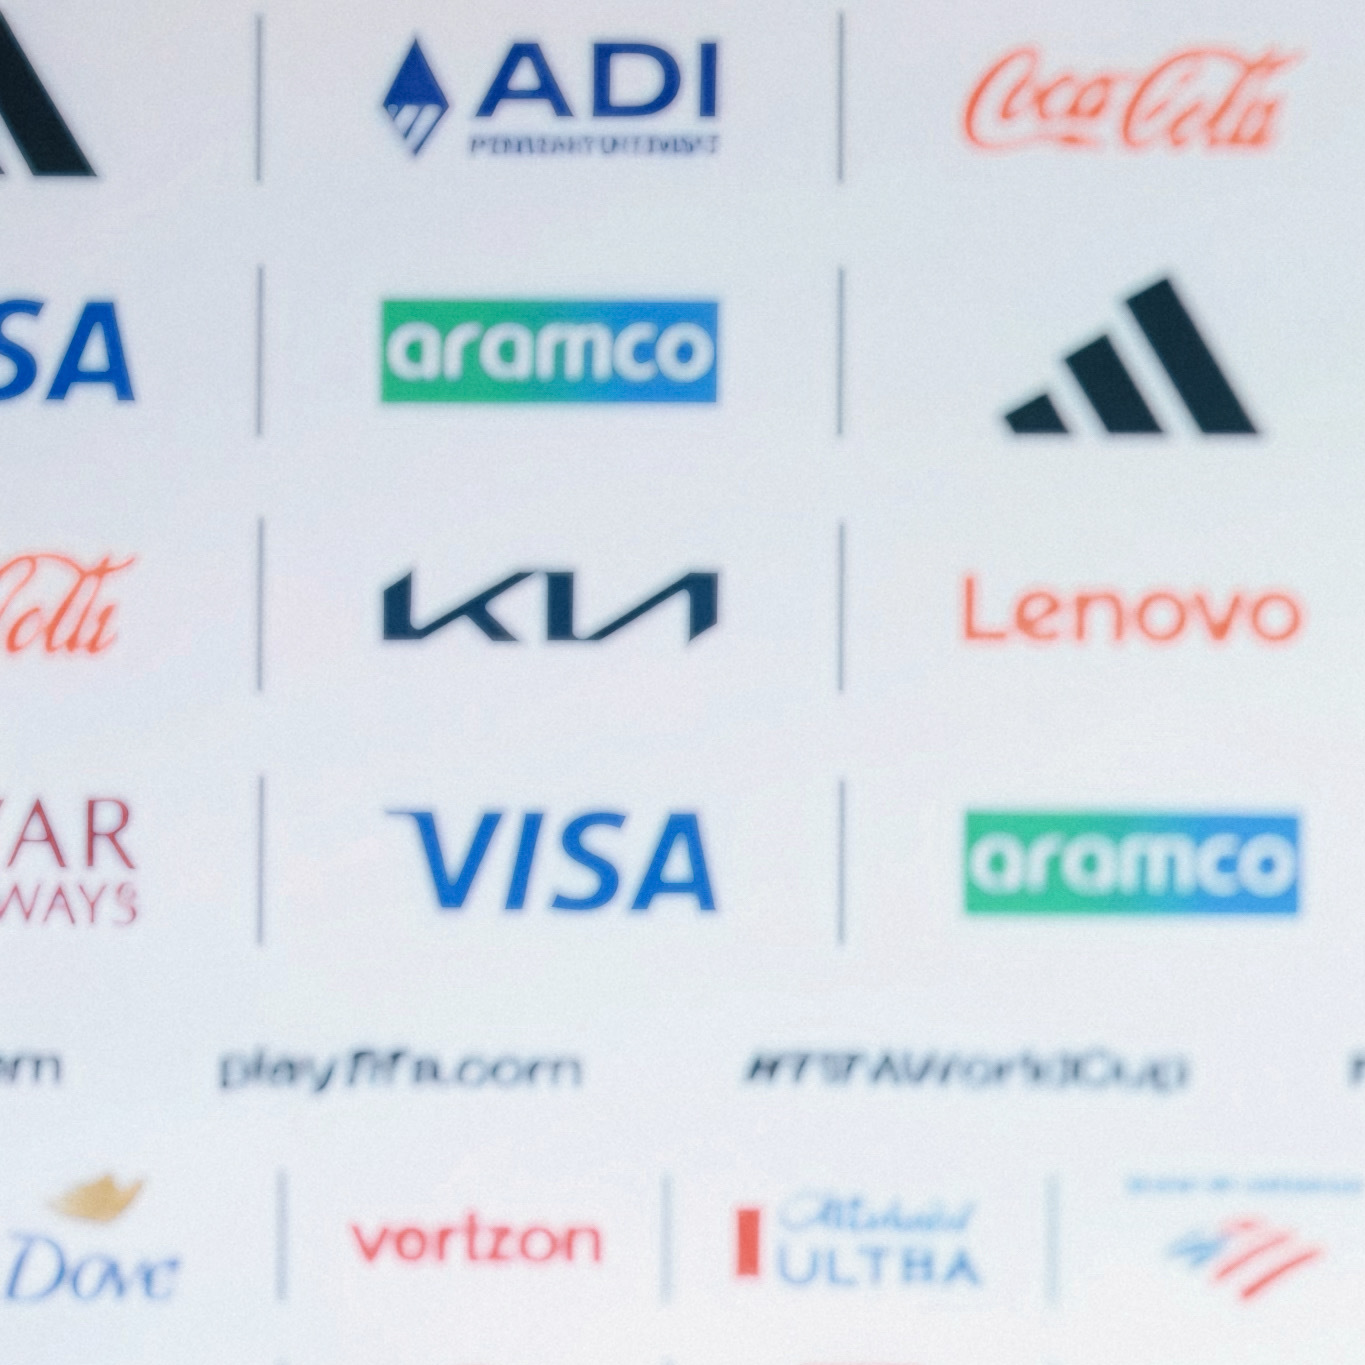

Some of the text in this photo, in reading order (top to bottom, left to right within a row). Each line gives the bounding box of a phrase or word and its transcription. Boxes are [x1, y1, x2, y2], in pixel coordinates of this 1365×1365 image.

[475, 41, 719, 118] ADI
[0, 297, 135, 402] SA
[385, 321, 714, 382] aramco
[962, 575, 1302, 643] Lenovo
[387, 810, 717, 912] VISA
[968, 833, 1297, 896] aramco
[0, 882, 138, 925] WAYS
